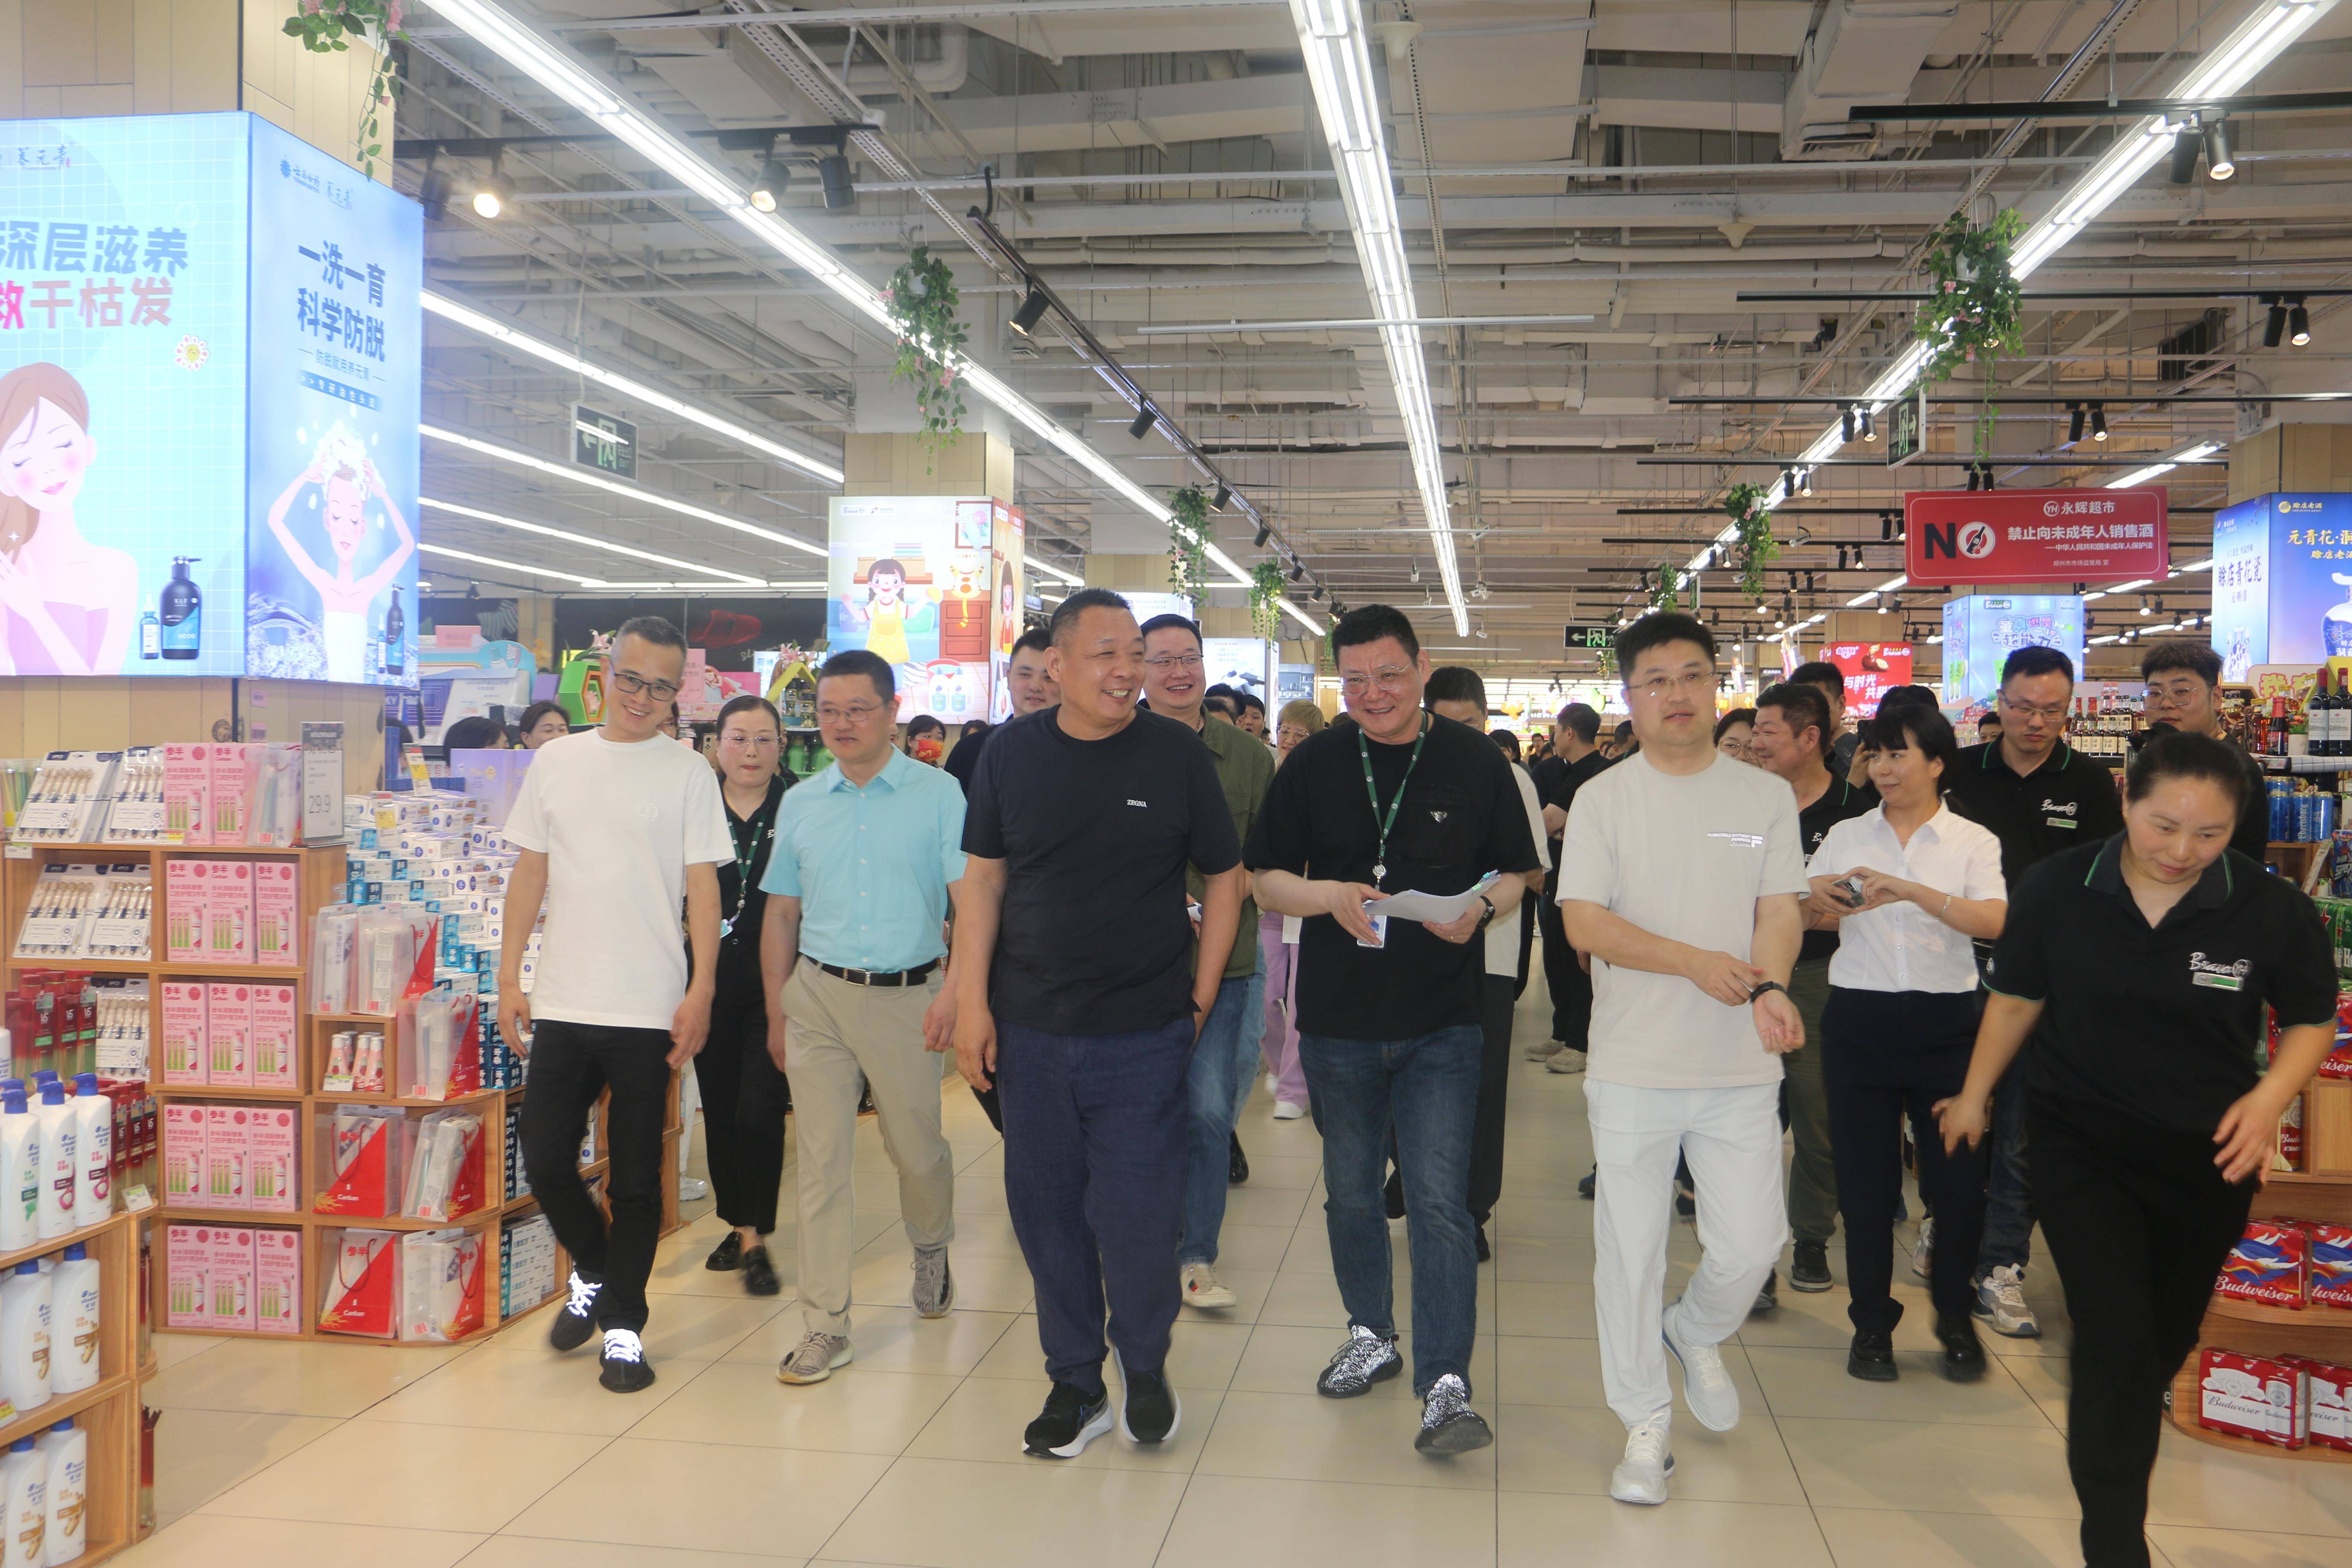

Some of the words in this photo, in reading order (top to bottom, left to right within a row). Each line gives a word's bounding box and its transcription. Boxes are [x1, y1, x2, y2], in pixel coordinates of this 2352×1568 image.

[0, 220, 188, 278] 深层滋养
[298, 239, 386, 308] 一洗一育
[297, 287, 386, 362] 科学防脱
[2061, 501, 2115, 515] 永辉超市
[2007, 523, 2154, 541] 禁止向未成年人销售酒
[2218, 556, 2262, 588] 赊店青花瓷
[1997, 616, 2053, 634] 童真也是
[2033, 628, 2057, 637] 一种
[2002, 632, 2051, 648] 超能力
[1883, 647, 1902, 656] Bravo
[1843, 674, 1877, 693] 与时光
[309, 794, 331, 814] 29.9
[1127, 799, 1147, 808] ZEGNA
[2189, 952, 2233, 974] Bravo
[167, 1109, 184, 1117] 参半
[210, 1110, 227, 1118] 参半
[253, 1112, 270, 1121] 参半
[171, 1229, 189, 1237] 参半
[214, 1231, 230, 1240] 参半
[260, 1234, 276, 1242] 参半
[347, 1246, 368, 1256] 参半
[2215, 1276, 2294, 1301] Budweiser
[2206, 1394, 2260, 1415] Budweiser
